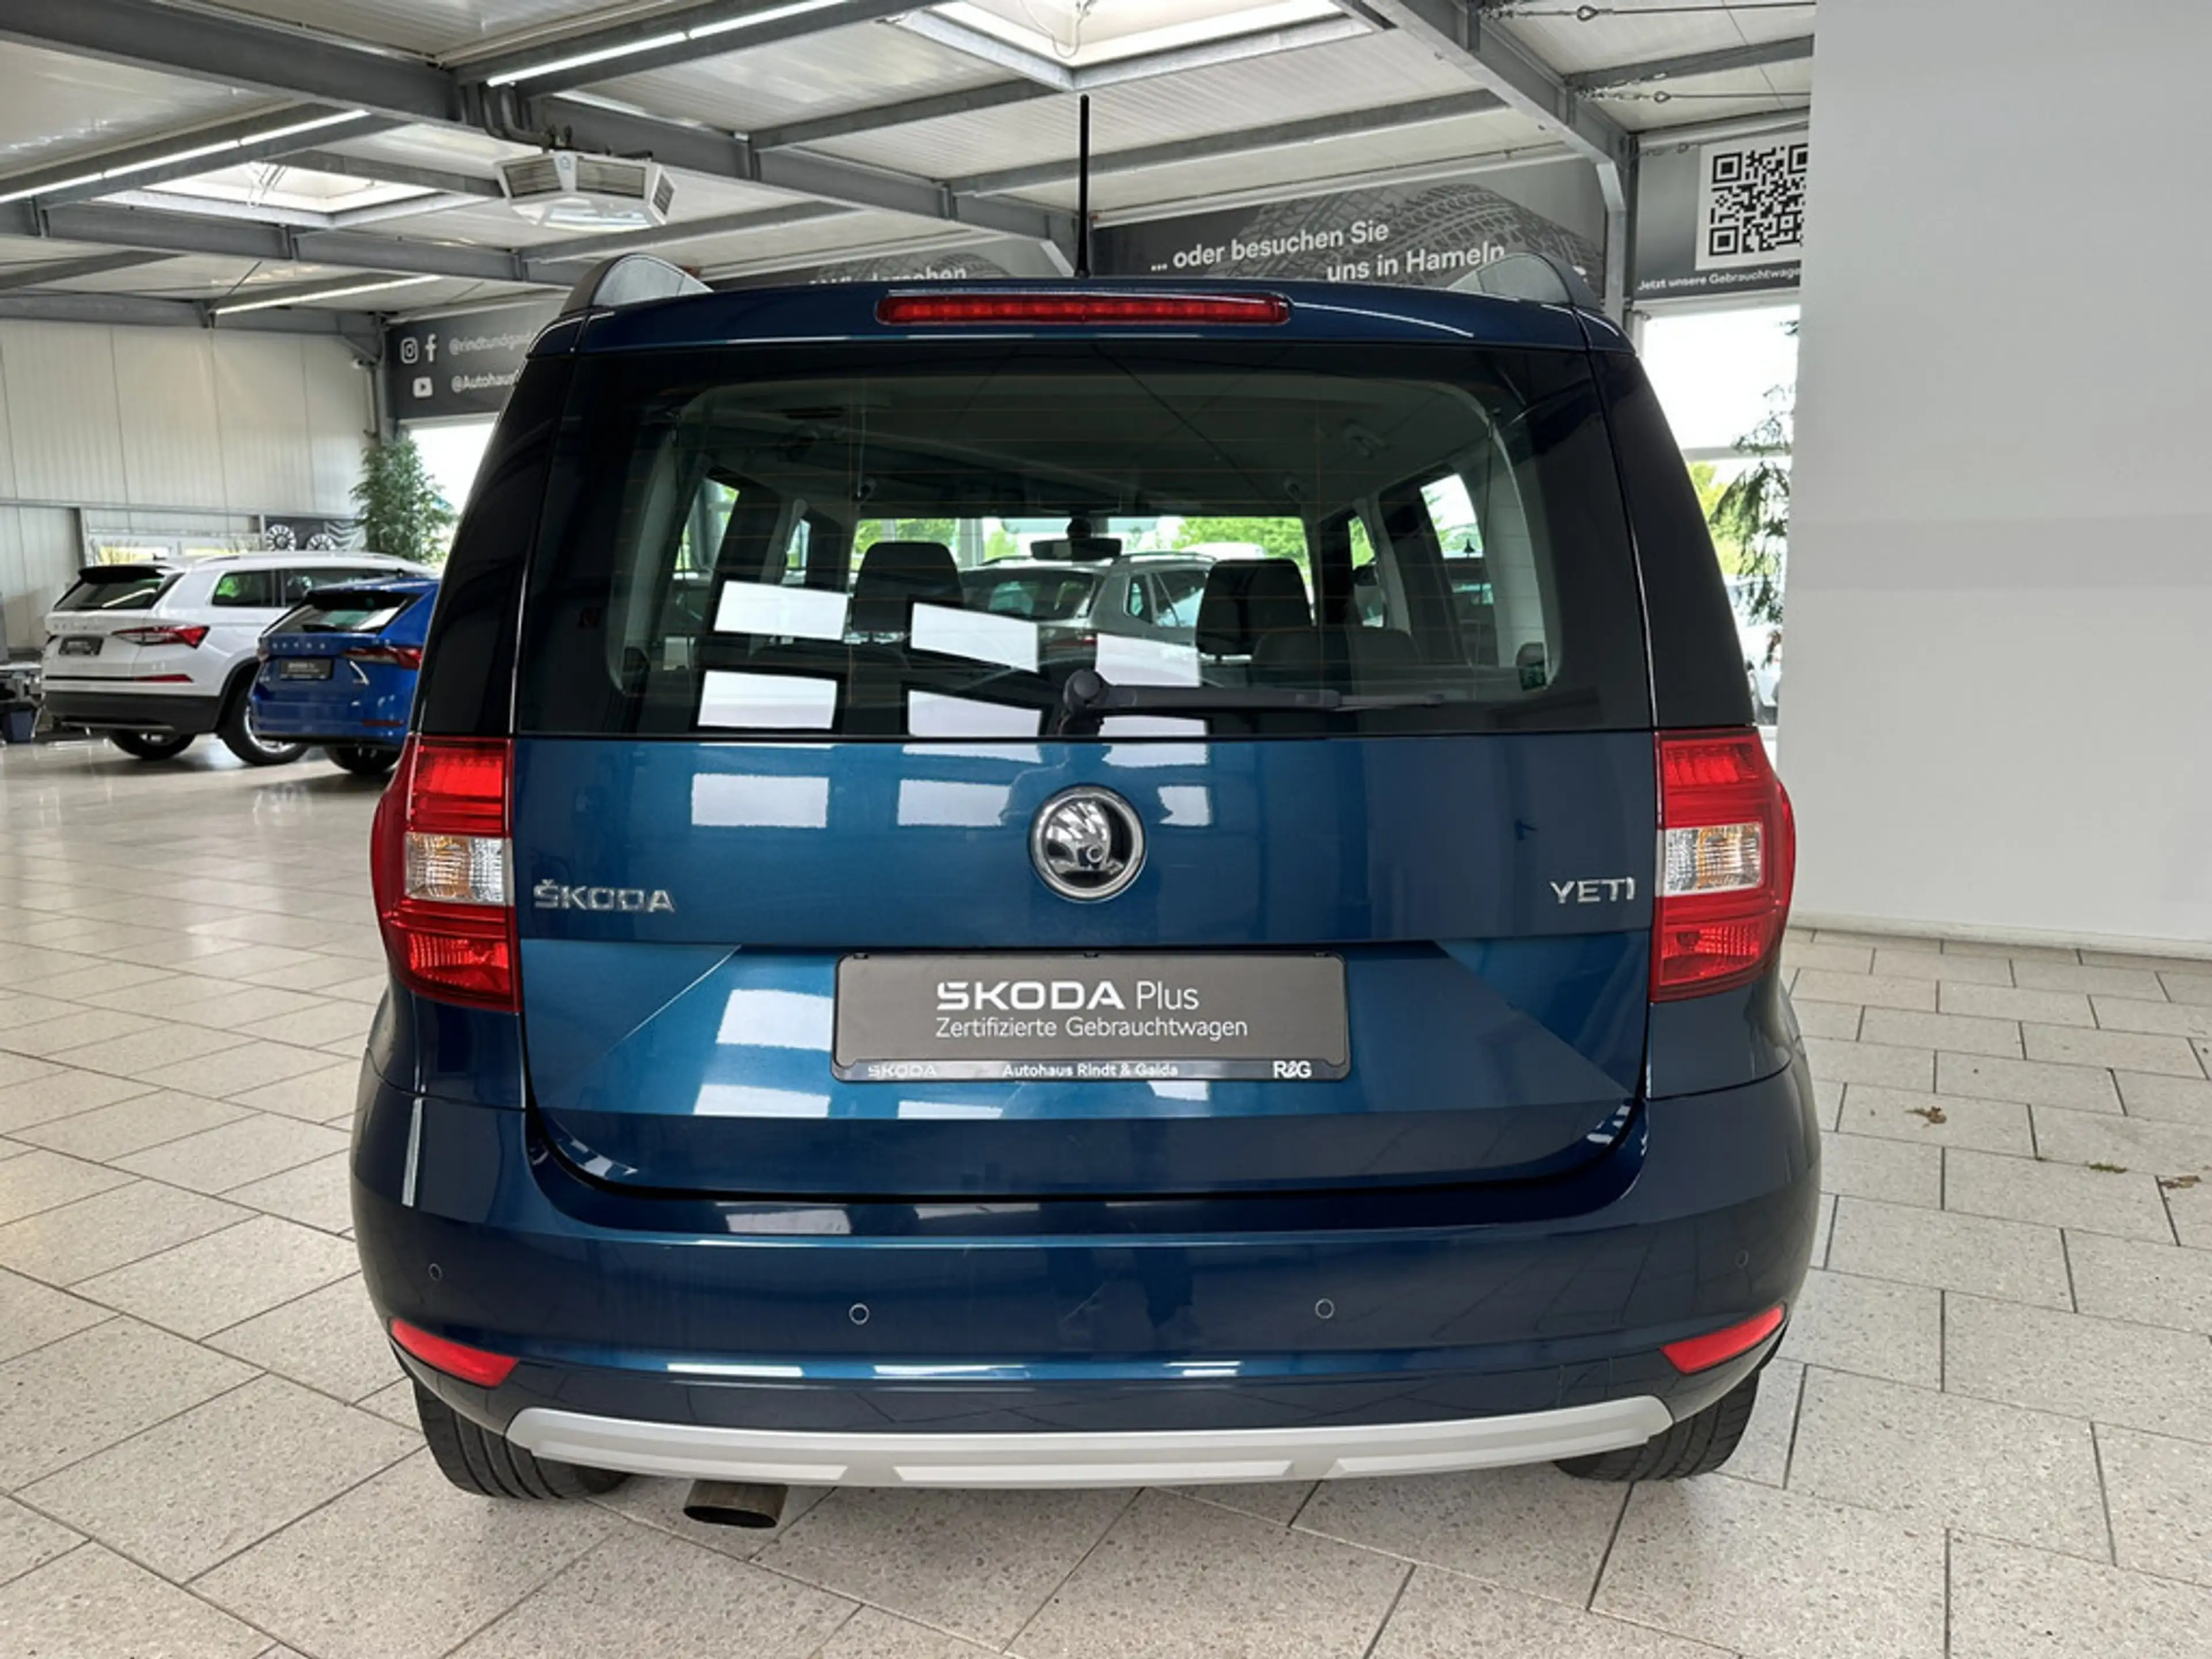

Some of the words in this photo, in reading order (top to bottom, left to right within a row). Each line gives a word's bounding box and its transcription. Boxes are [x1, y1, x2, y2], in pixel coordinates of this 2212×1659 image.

[1173, 244, 1225, 268] oder
[1231, 229, 1344, 260] besuchen
[1350, 220, 1389, 244] Sie
[1327, 260, 1370, 282] uns
[1377, 253, 1399, 277] in
[1406, 241, 1505, 274] Hameln
[1638, 280, 1666, 290] Jetzt
[1668, 275, 1707, 287] unsere
[1549, 876, 1635, 904] YETI
[1137, 980, 1200, 1010] Plus
[935, 1017, 1057, 1037] Zertifizierte
[1065, 1016, 1248, 1041] Gebrauchtwagen
[1002, 1063, 1074, 1078] Autohaus
[1077, 1063, 1116, 1077] Rindt
[1119, 1064, 1132, 1078] &
